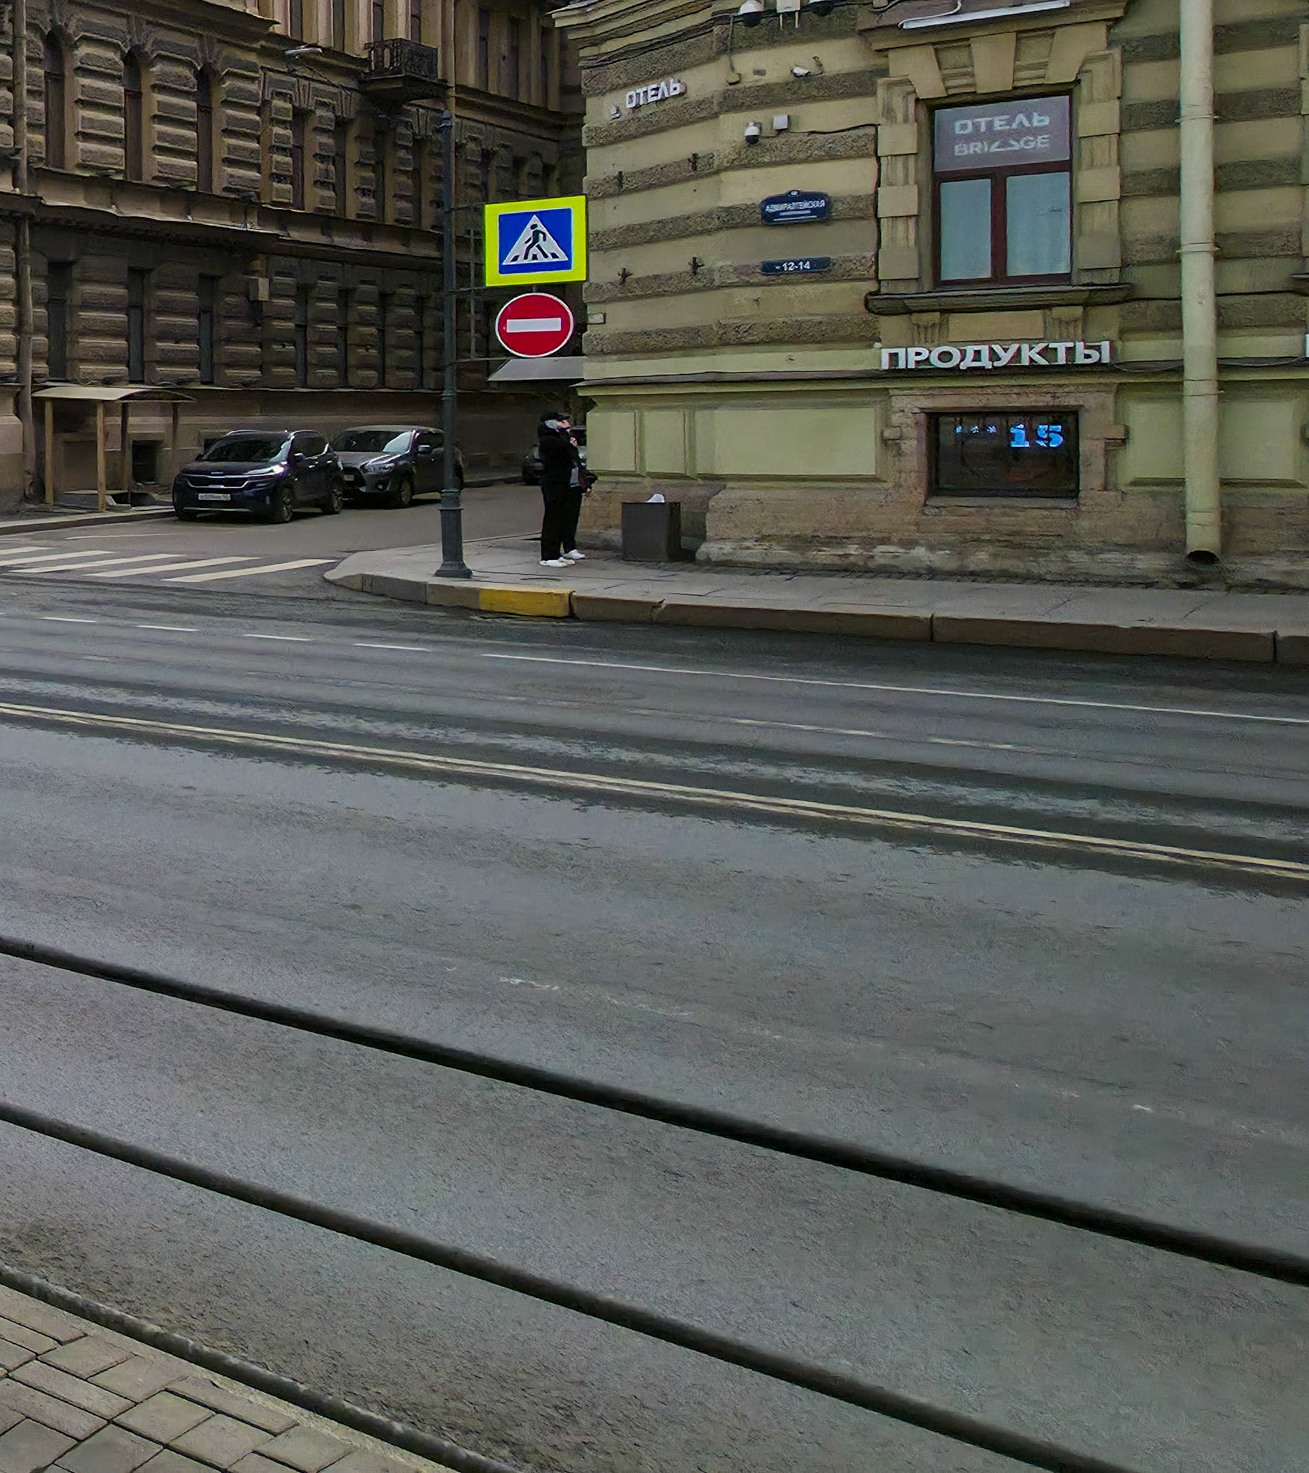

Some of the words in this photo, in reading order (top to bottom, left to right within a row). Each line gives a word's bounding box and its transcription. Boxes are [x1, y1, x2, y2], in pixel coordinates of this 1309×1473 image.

[625, 79, 683, 109] ОТЕЛЬ
[954, 112, 1050, 134] ОТЕЛЬ
[782, 260, 811, 272] 12-14
[880, 341, 1111, 370] ПРОДУКТЫ
